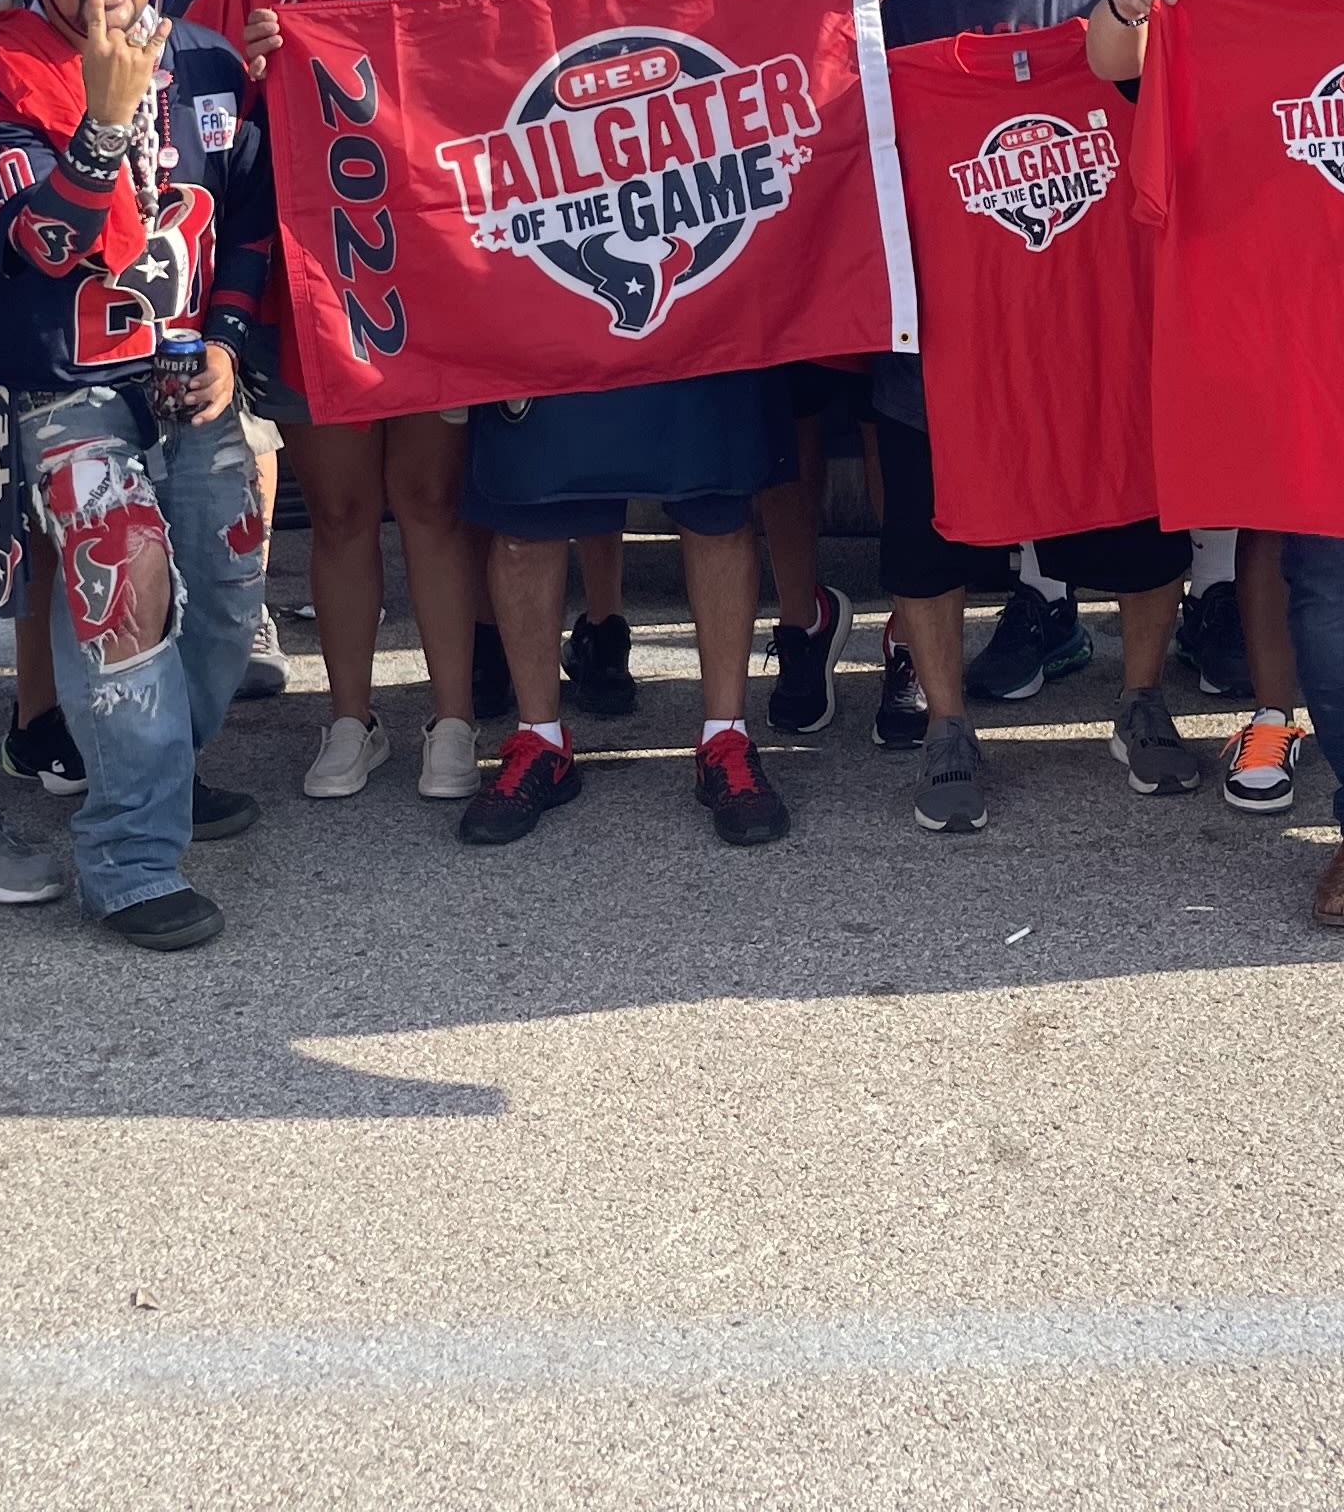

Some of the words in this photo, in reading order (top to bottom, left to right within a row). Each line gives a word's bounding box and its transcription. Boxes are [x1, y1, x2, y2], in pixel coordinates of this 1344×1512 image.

[441, 68, 816, 216] TAILGATER
[952, 132, 1117, 198] TAILGATER
[1308, 141, 1326, 158] OF
[311, 54, 408, 363] 2022
[511, 210, 546, 245] OF
[556, 192, 613, 234] THE
[618, 143, 784, 242] GAME
[983, 194, 999, 210] OF
[1004, 188, 1027, 205] THE
[1029, 169, 1103, 209] GAME
[931, 770, 972, 786] PUMA
